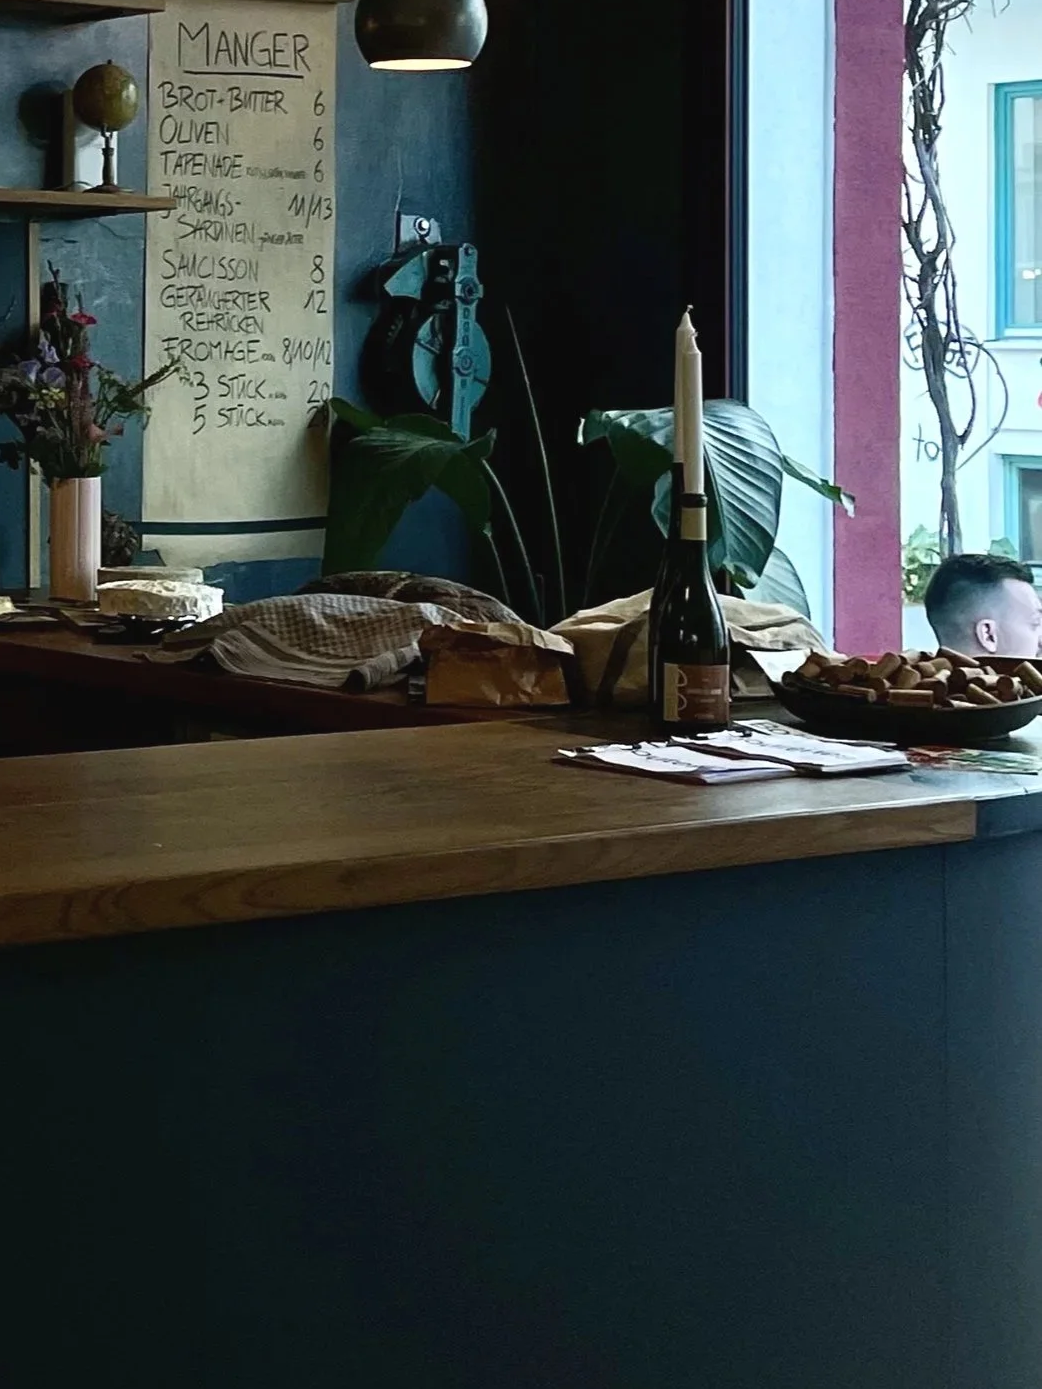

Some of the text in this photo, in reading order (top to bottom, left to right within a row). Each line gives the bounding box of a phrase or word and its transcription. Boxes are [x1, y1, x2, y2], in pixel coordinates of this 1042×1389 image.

[178, 22, 311, 72] MANGER
[313, 91, 325, 116] 6
[159, 114, 324, 151] OLIVEN 6
[160, 150, 243, 179] TAPENADE
[313, 160, 324, 183] 6
[176, 213, 256, 244] SARDINEN
[161, 249, 325, 284] SAUCISSON 8
[304, 290, 327, 314] 12
[161, 337, 261, 365] FROMAGE
[193, 371, 210, 401] 3
[306, 380, 331, 403] 20
[193, 404, 207, 435] 5
